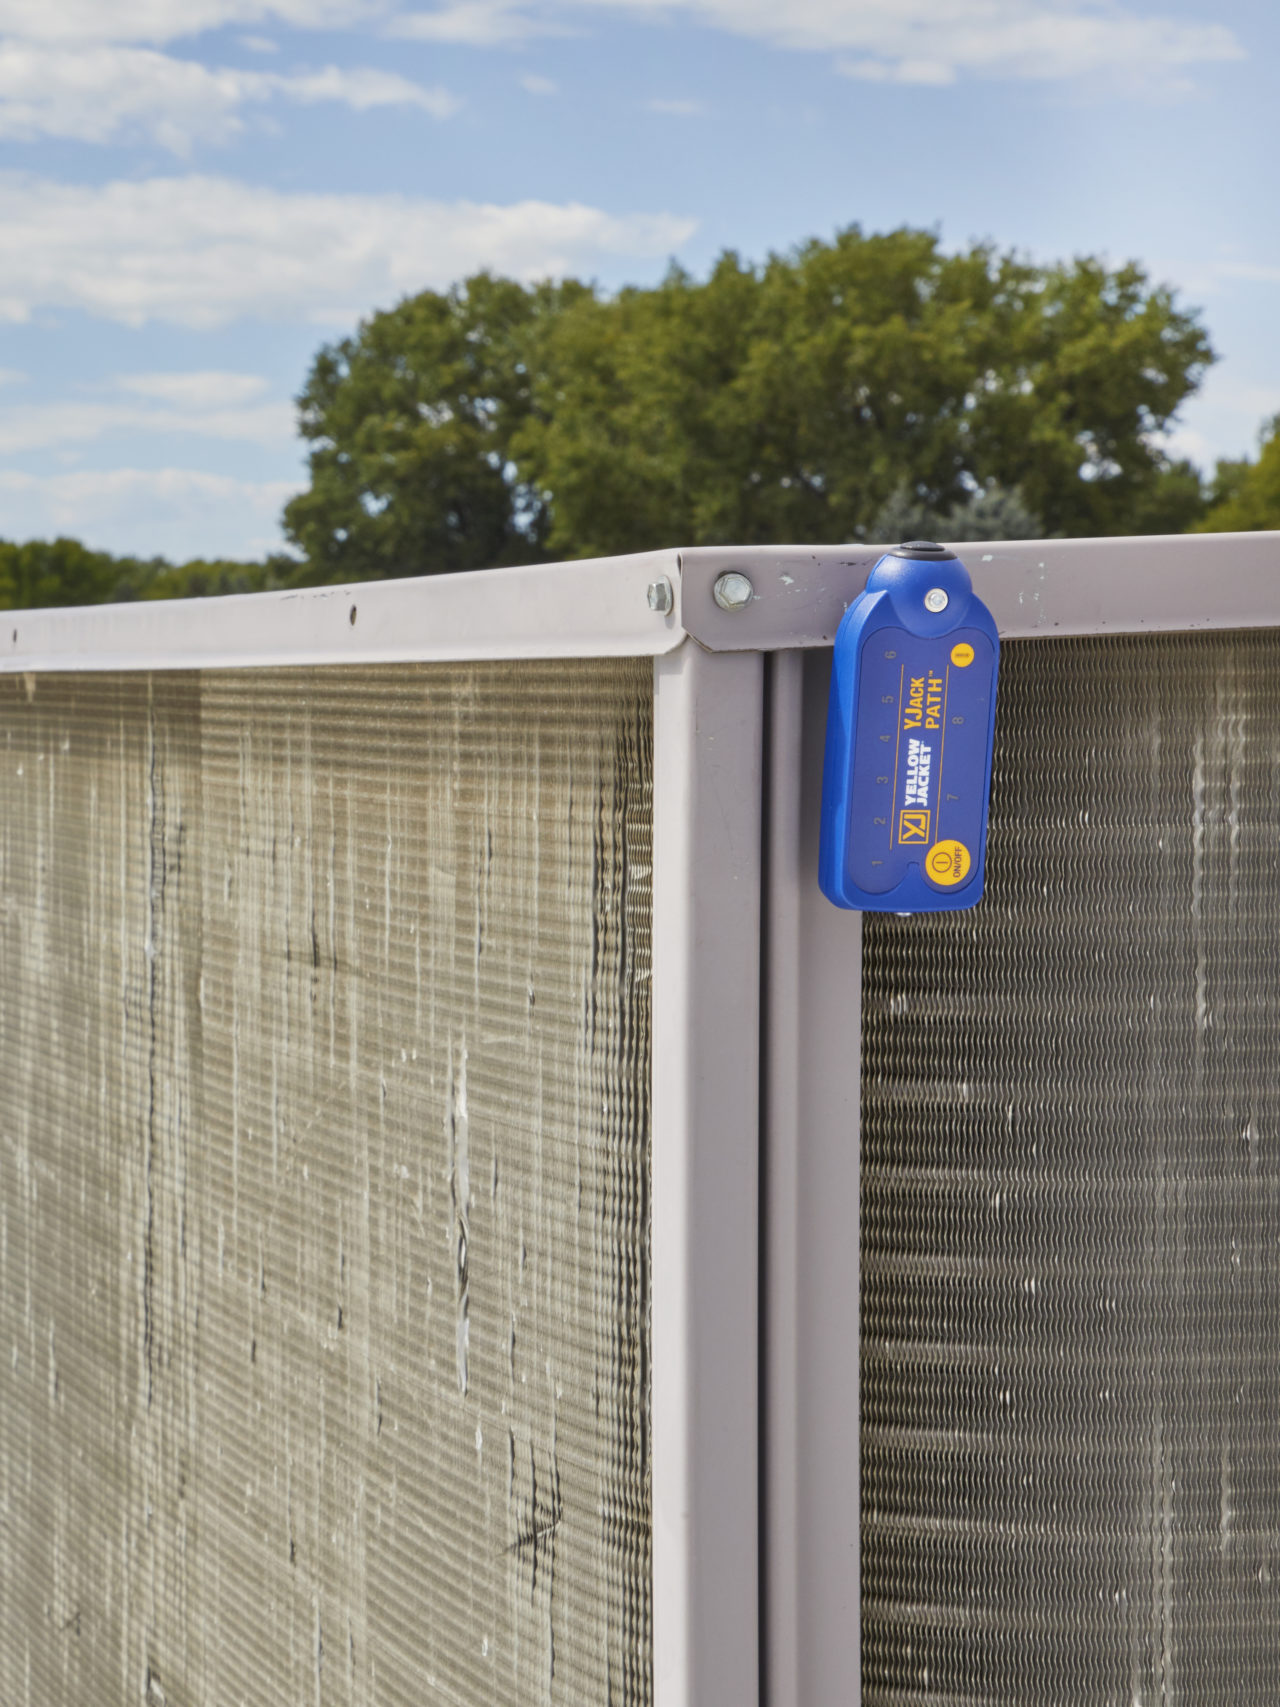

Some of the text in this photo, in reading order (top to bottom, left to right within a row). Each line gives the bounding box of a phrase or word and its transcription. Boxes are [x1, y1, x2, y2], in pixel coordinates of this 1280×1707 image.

[885, 651, 896, 659] 6
[882, 695, 894, 704] 5
[952, 716, 964, 724] 8
[905, 738, 920, 806] YELLOW
[918, 744, 931, 806] JACKET
[877, 776, 888, 784] 3
[874, 817, 886, 825] 2
[902, 814, 926, 841] YJ
[952, 845, 963, 878] ON/OFF
